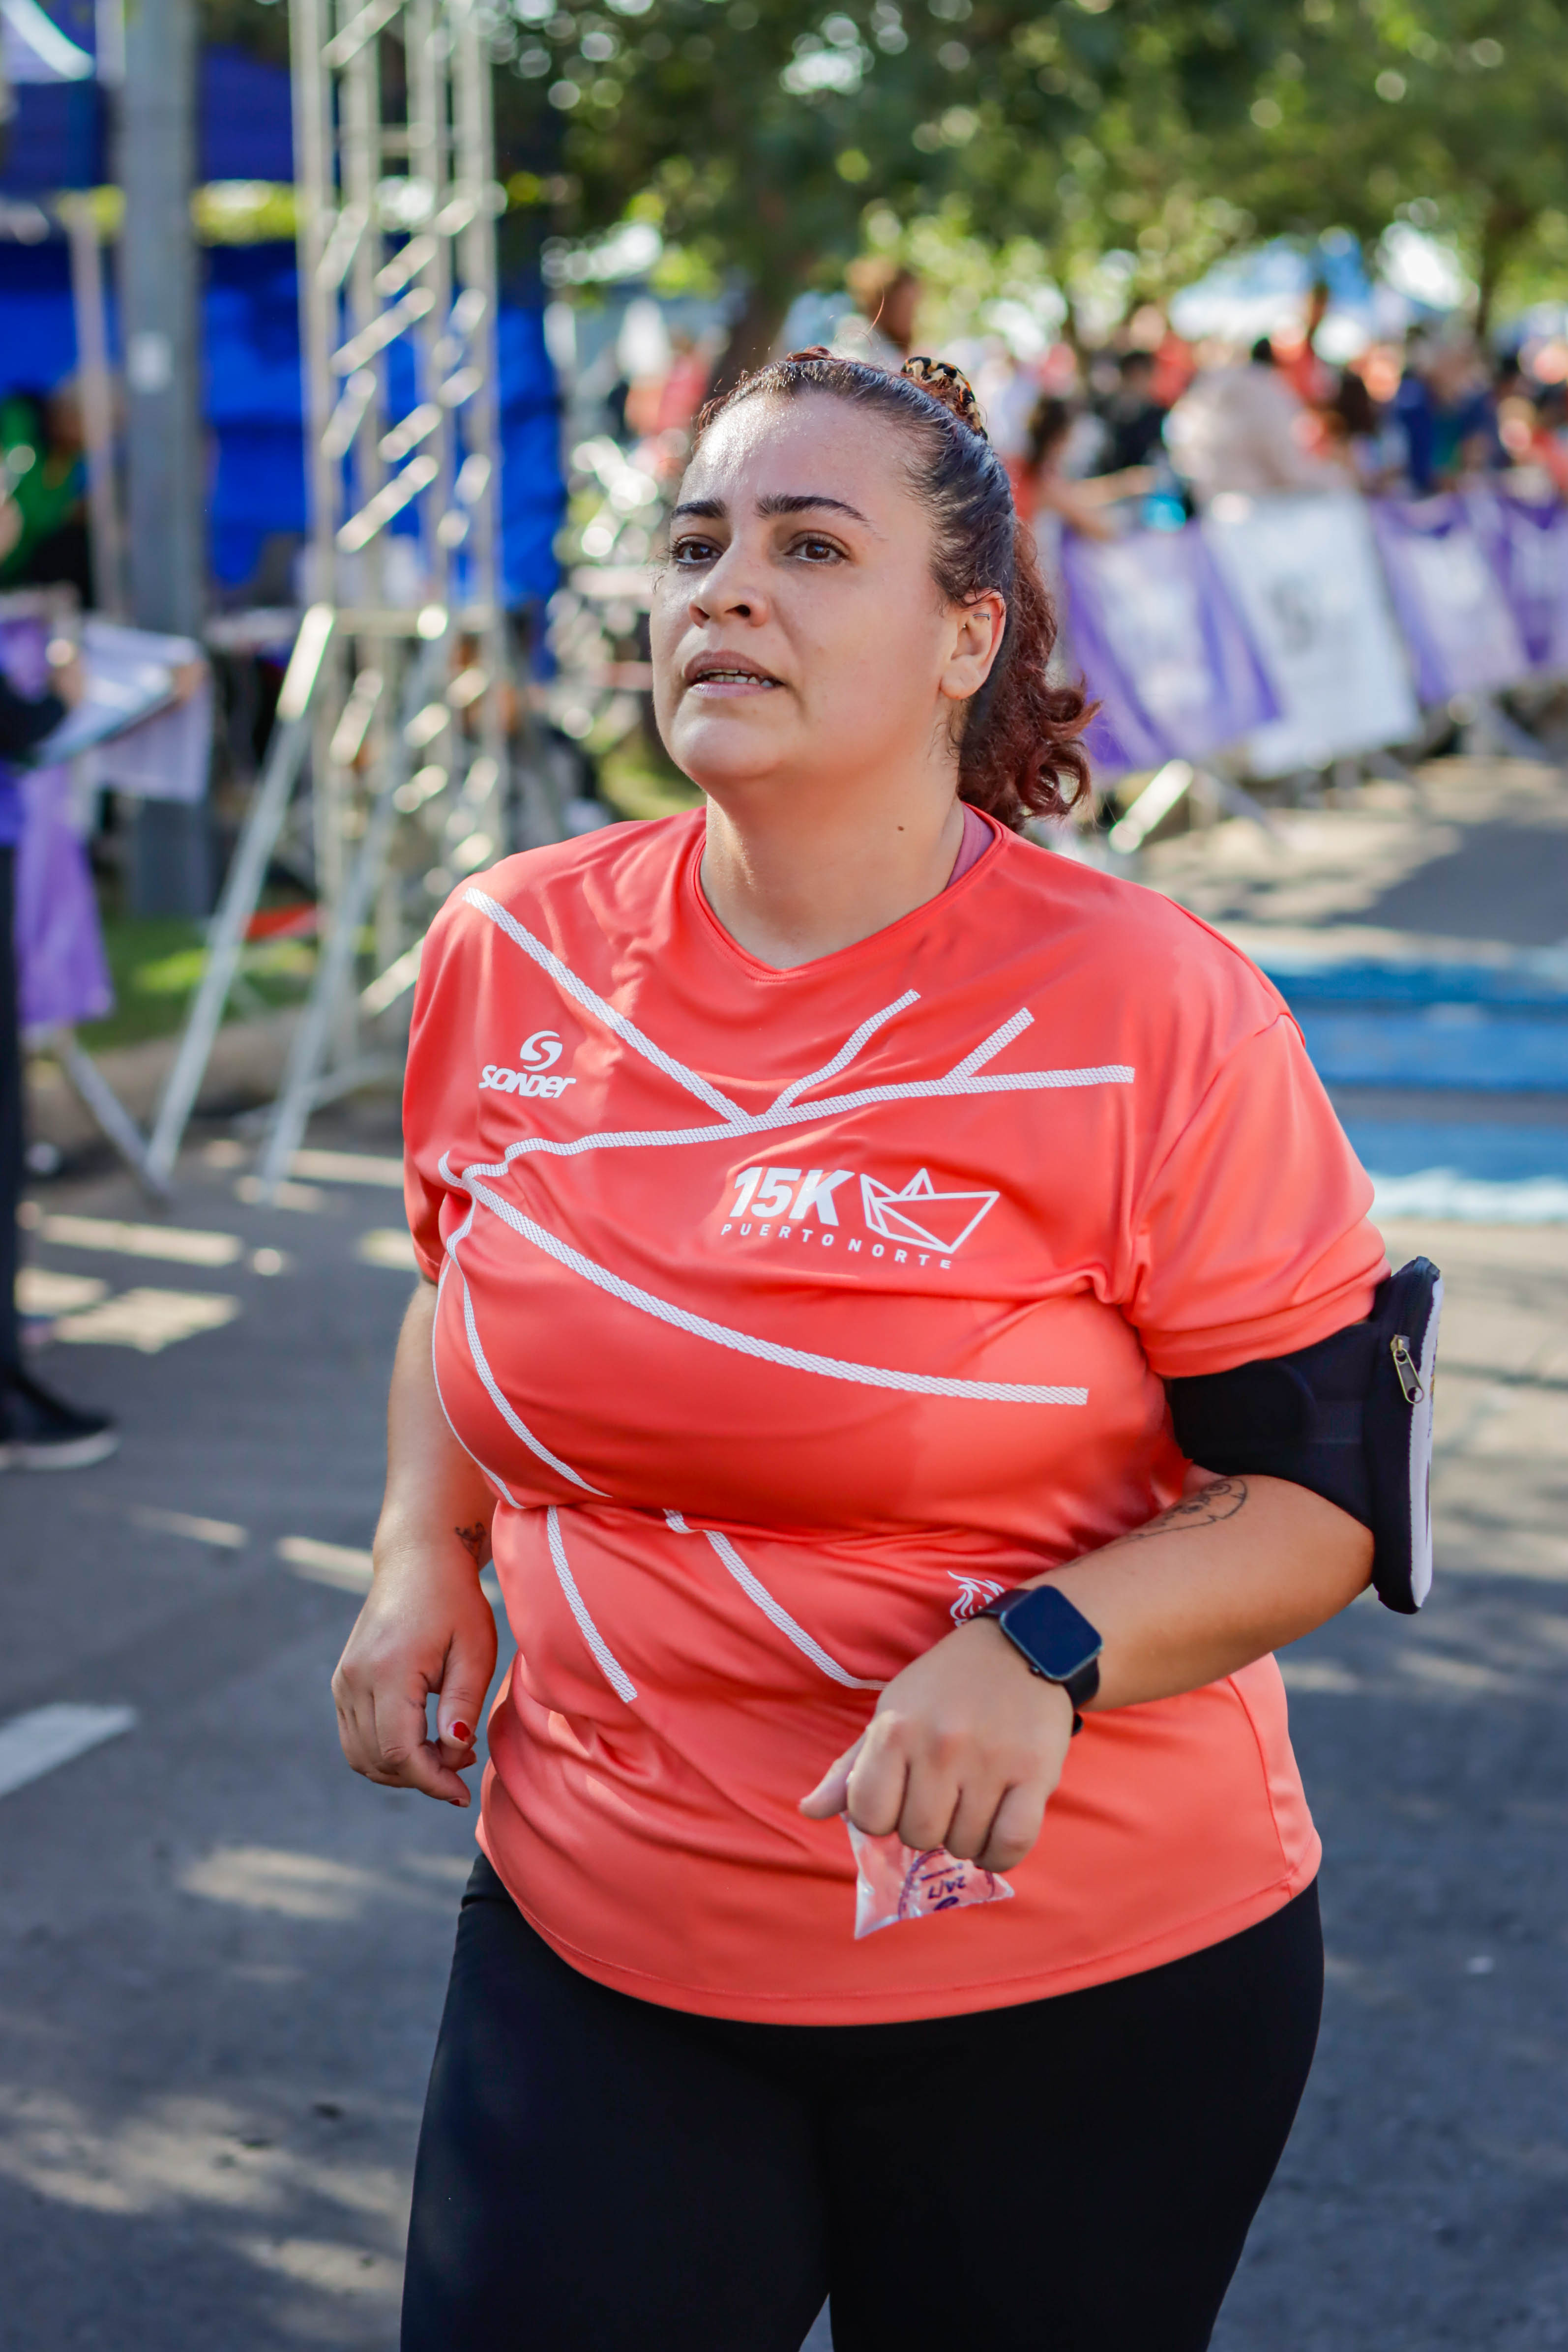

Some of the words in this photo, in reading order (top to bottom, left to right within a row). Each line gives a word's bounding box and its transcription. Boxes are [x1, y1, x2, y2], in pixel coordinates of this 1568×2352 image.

[729, 1167, 856, 1227] 15K
[720, 1223, 835, 1247] PUERTO
[848, 1238, 952, 1270] NORTE
